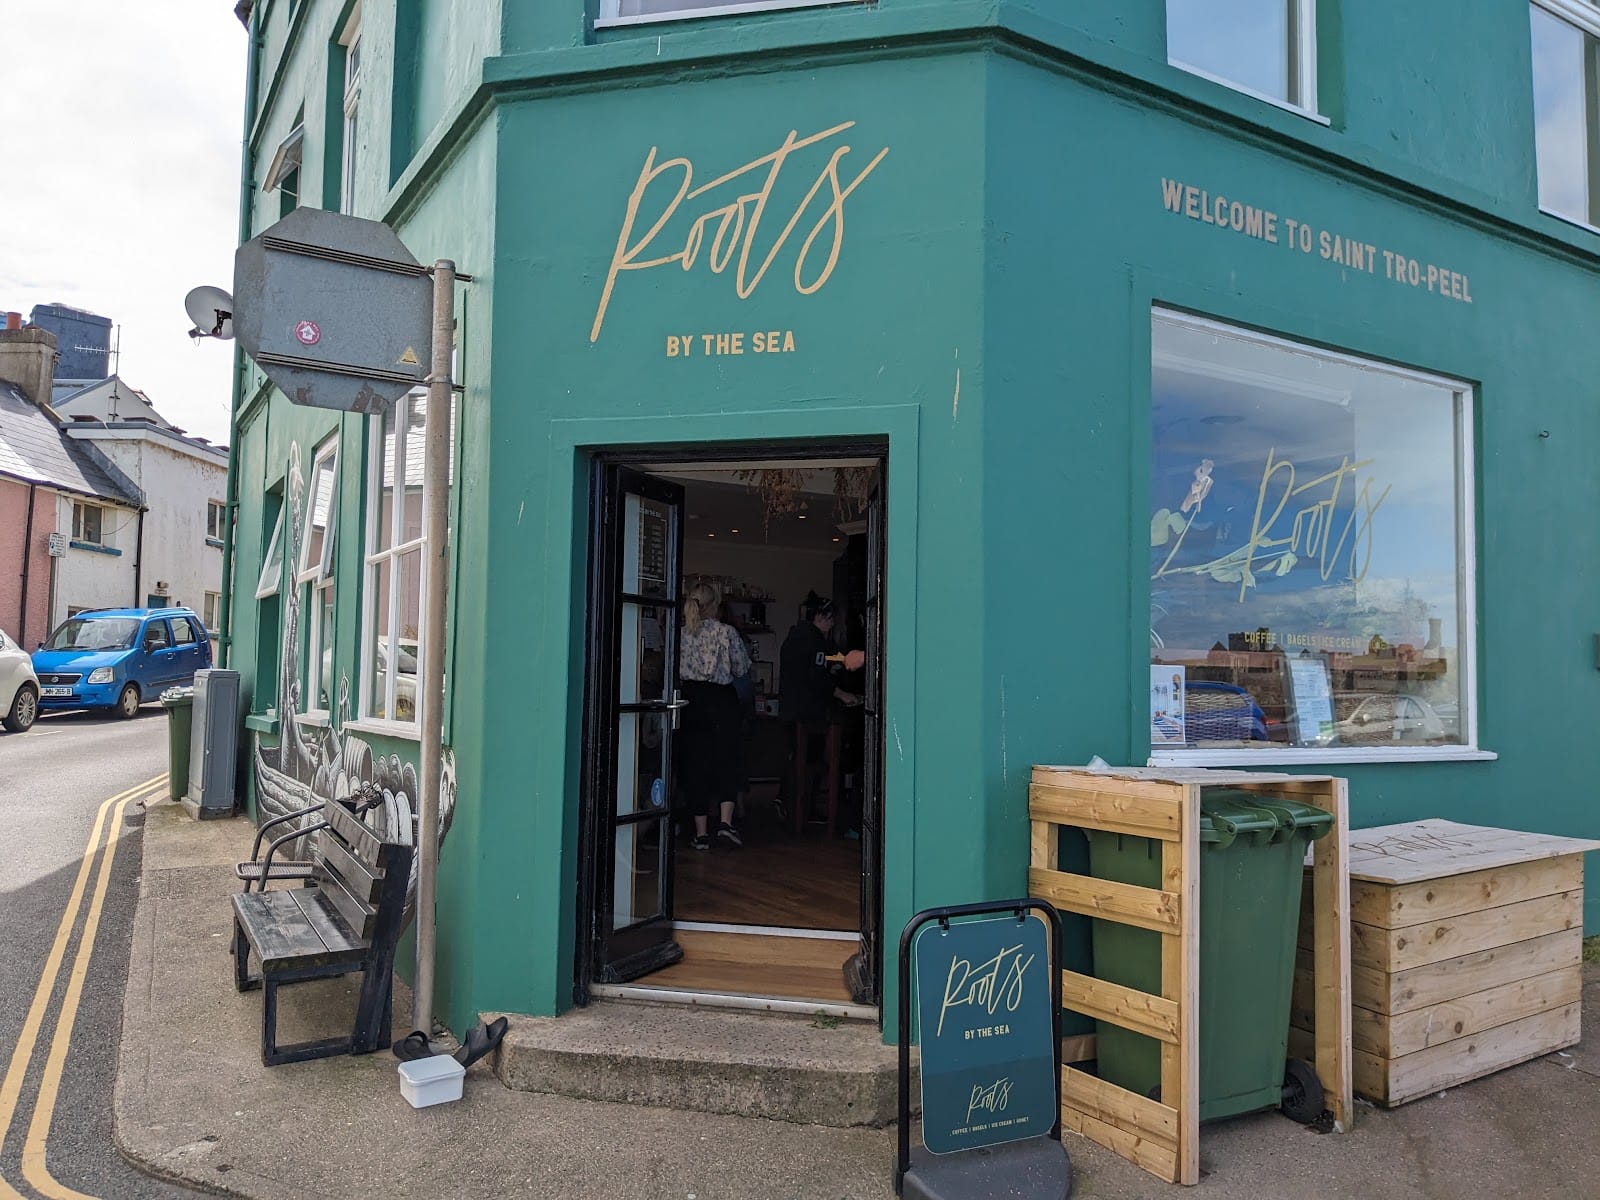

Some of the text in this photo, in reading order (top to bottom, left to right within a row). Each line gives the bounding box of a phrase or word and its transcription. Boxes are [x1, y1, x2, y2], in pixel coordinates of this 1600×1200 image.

[590, 120, 889, 343] Roots
[1161, 177, 1473, 304] WELCOME TO SAINT TRO-PEEL
[666, 330, 795, 357] BY THE SEA
[1239, 446, 1393, 603] Roots
[1244, 631, 1277, 645] COFFEE
[1287, 633, 1316, 647] BAGELS
[937, 943, 1035, 1037] Roots
[964, 1024, 1010, 1040] BY THE SEA
[966, 1076, 1015, 1124] Roots
